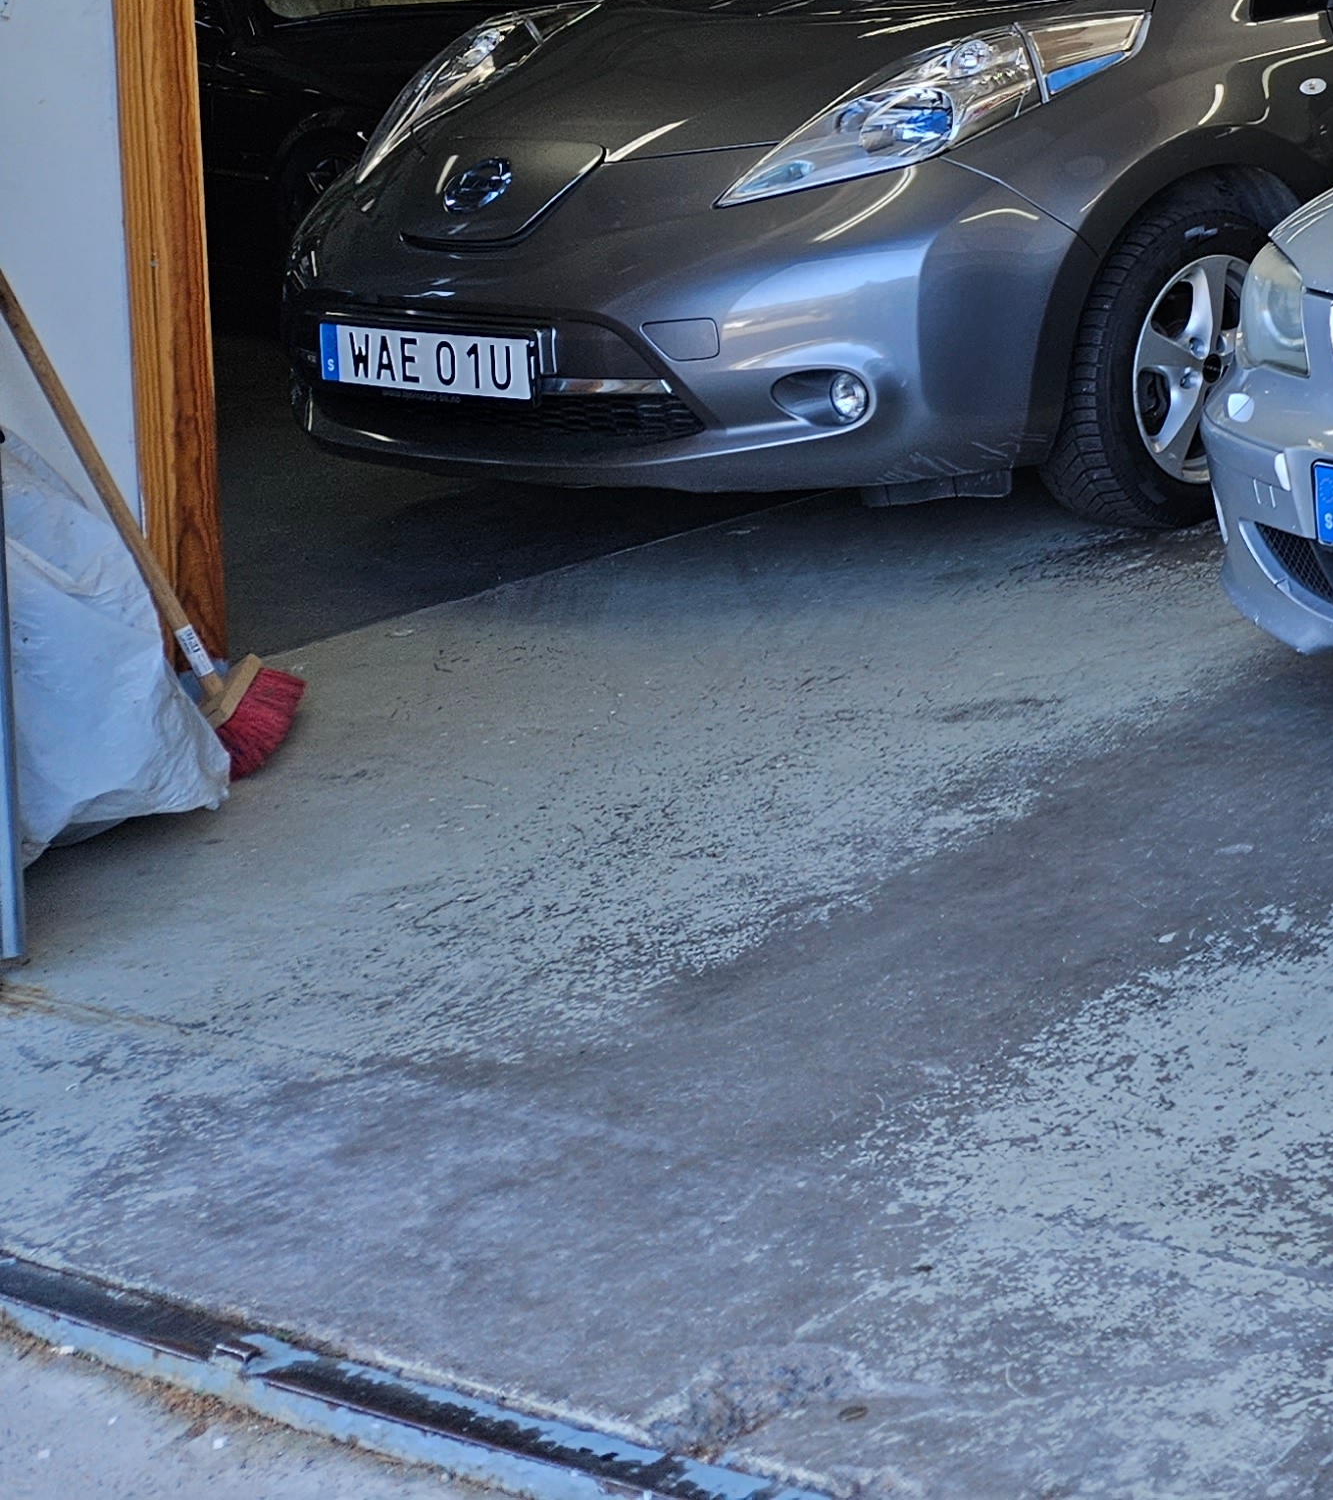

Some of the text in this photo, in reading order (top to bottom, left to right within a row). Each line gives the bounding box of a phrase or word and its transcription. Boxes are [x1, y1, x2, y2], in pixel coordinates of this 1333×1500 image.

[327, 331, 513, 391] S WAE 01U
[1324, 512, 1333, 530] S
